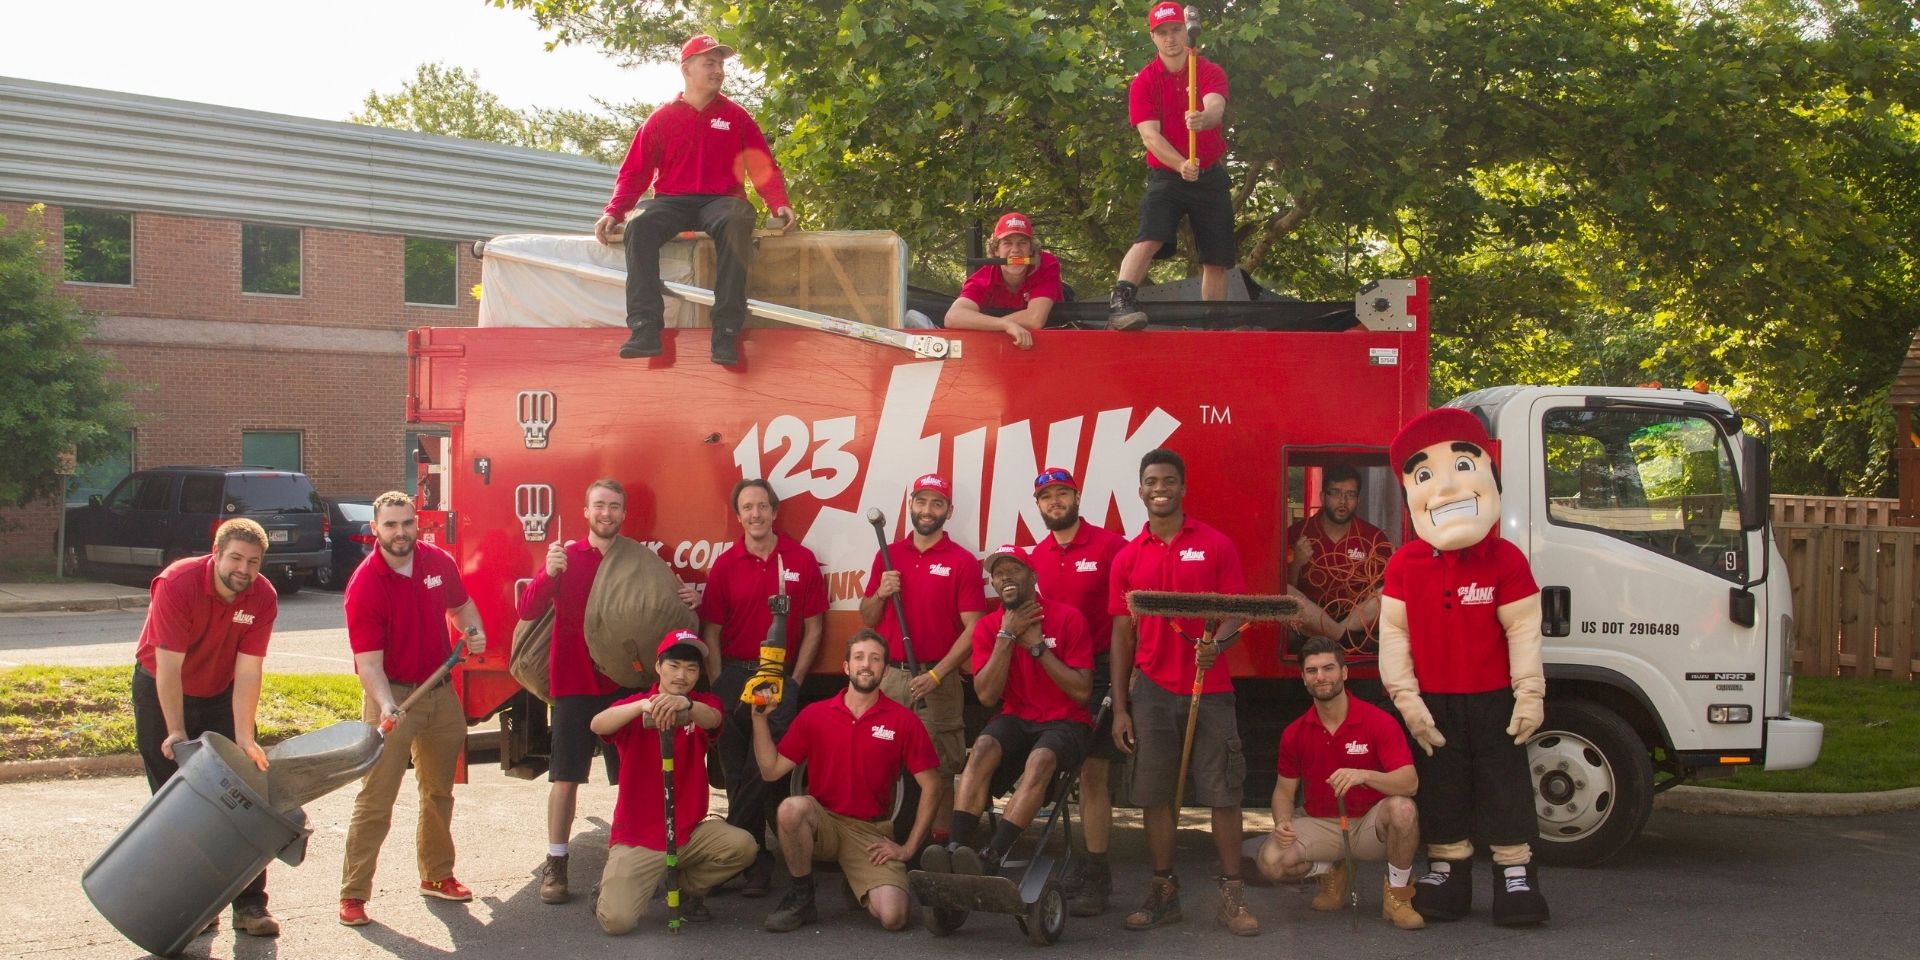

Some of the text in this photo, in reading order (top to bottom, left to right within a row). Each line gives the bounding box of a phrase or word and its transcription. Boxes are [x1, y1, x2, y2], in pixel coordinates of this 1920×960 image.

[734, 361, 1232, 554] 123 JUNK TM
[1726, 552, 1735, 570] 9
[1581, 621, 1680, 636] US DOT 2916489
